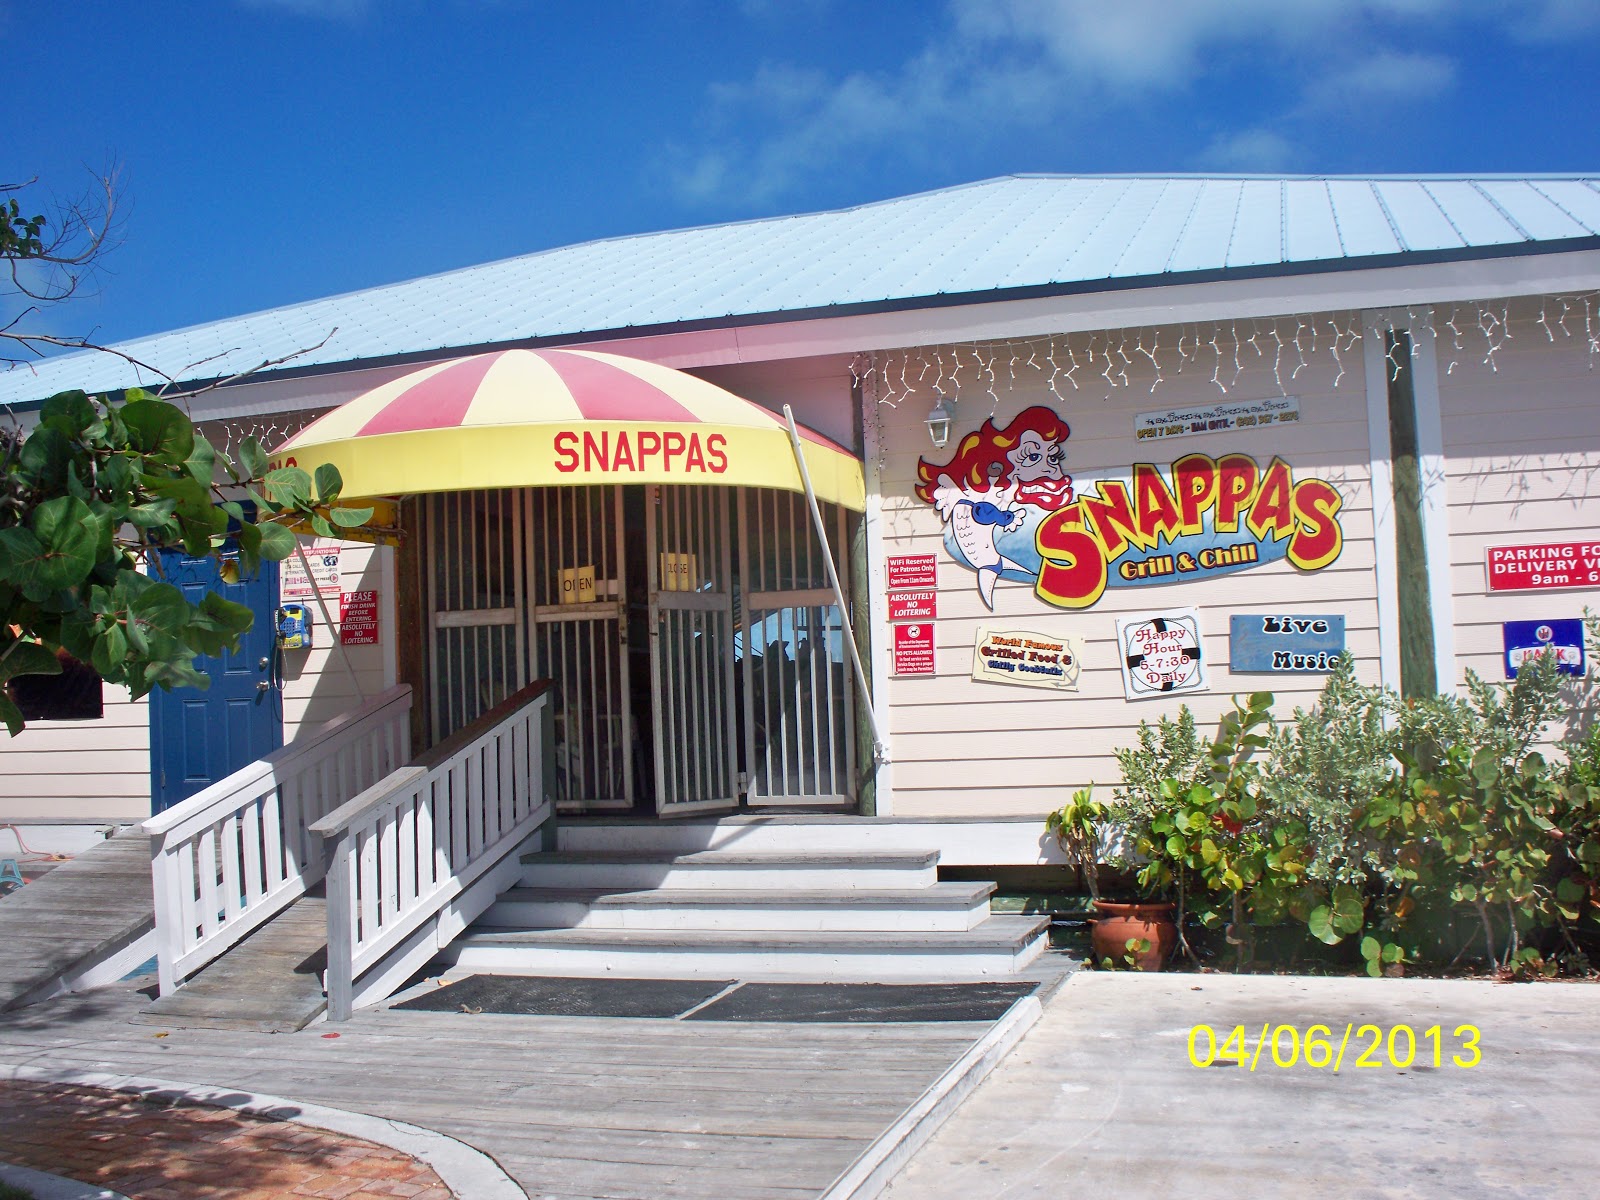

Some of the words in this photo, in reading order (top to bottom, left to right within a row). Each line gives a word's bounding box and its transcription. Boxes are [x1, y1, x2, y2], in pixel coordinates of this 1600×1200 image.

[1137, 428, 1157, 439] OPEN
[1158, 427, 1164, 436] 7
[1166, 425, 1184, 436] DAYS
[554, 431, 728, 473] SNAPPAS
[1036, 453, 1343, 608] SNAPPAS
[906, 557, 933, 565] Reserved
[1119, 553, 1175, 580] Grill
[1176, 551, 1195, 573] &
[1198, 542, 1258, 569] Chill
[1493, 546, 1574, 562] PARKING
[1494, 560, 1577, 574] DELIVERY
[1532, 574, 1569, 585] 9am
[344, 591, 372, 603] PLEASE
[890, 592, 934, 601] ABSOLUTELY
[341, 602, 359, 610] FINISH
[894, 608, 931, 617] LOITERING
[1262, 616, 1330, 635] Live
[1135, 628, 1187, 643] Happy
[992, 636, 1023, 648] World
[1024, 639, 1064, 652] Famous
[1143, 643, 1183, 656] Hour
[981, 646, 1026, 660] Grilled
[1028, 651, 1060, 665] Food
[1061, 655, 1072, 665] &
[1272, 651, 1340, 671] Music
[1522, 647, 1569, 662] KAK
[988, 660, 1016, 672] Chilly
[1018, 663, 1064, 676] Cocktails
[1140, 655, 1191, 671] 5-7:30
[1146, 671, 1187, 684] Daily
